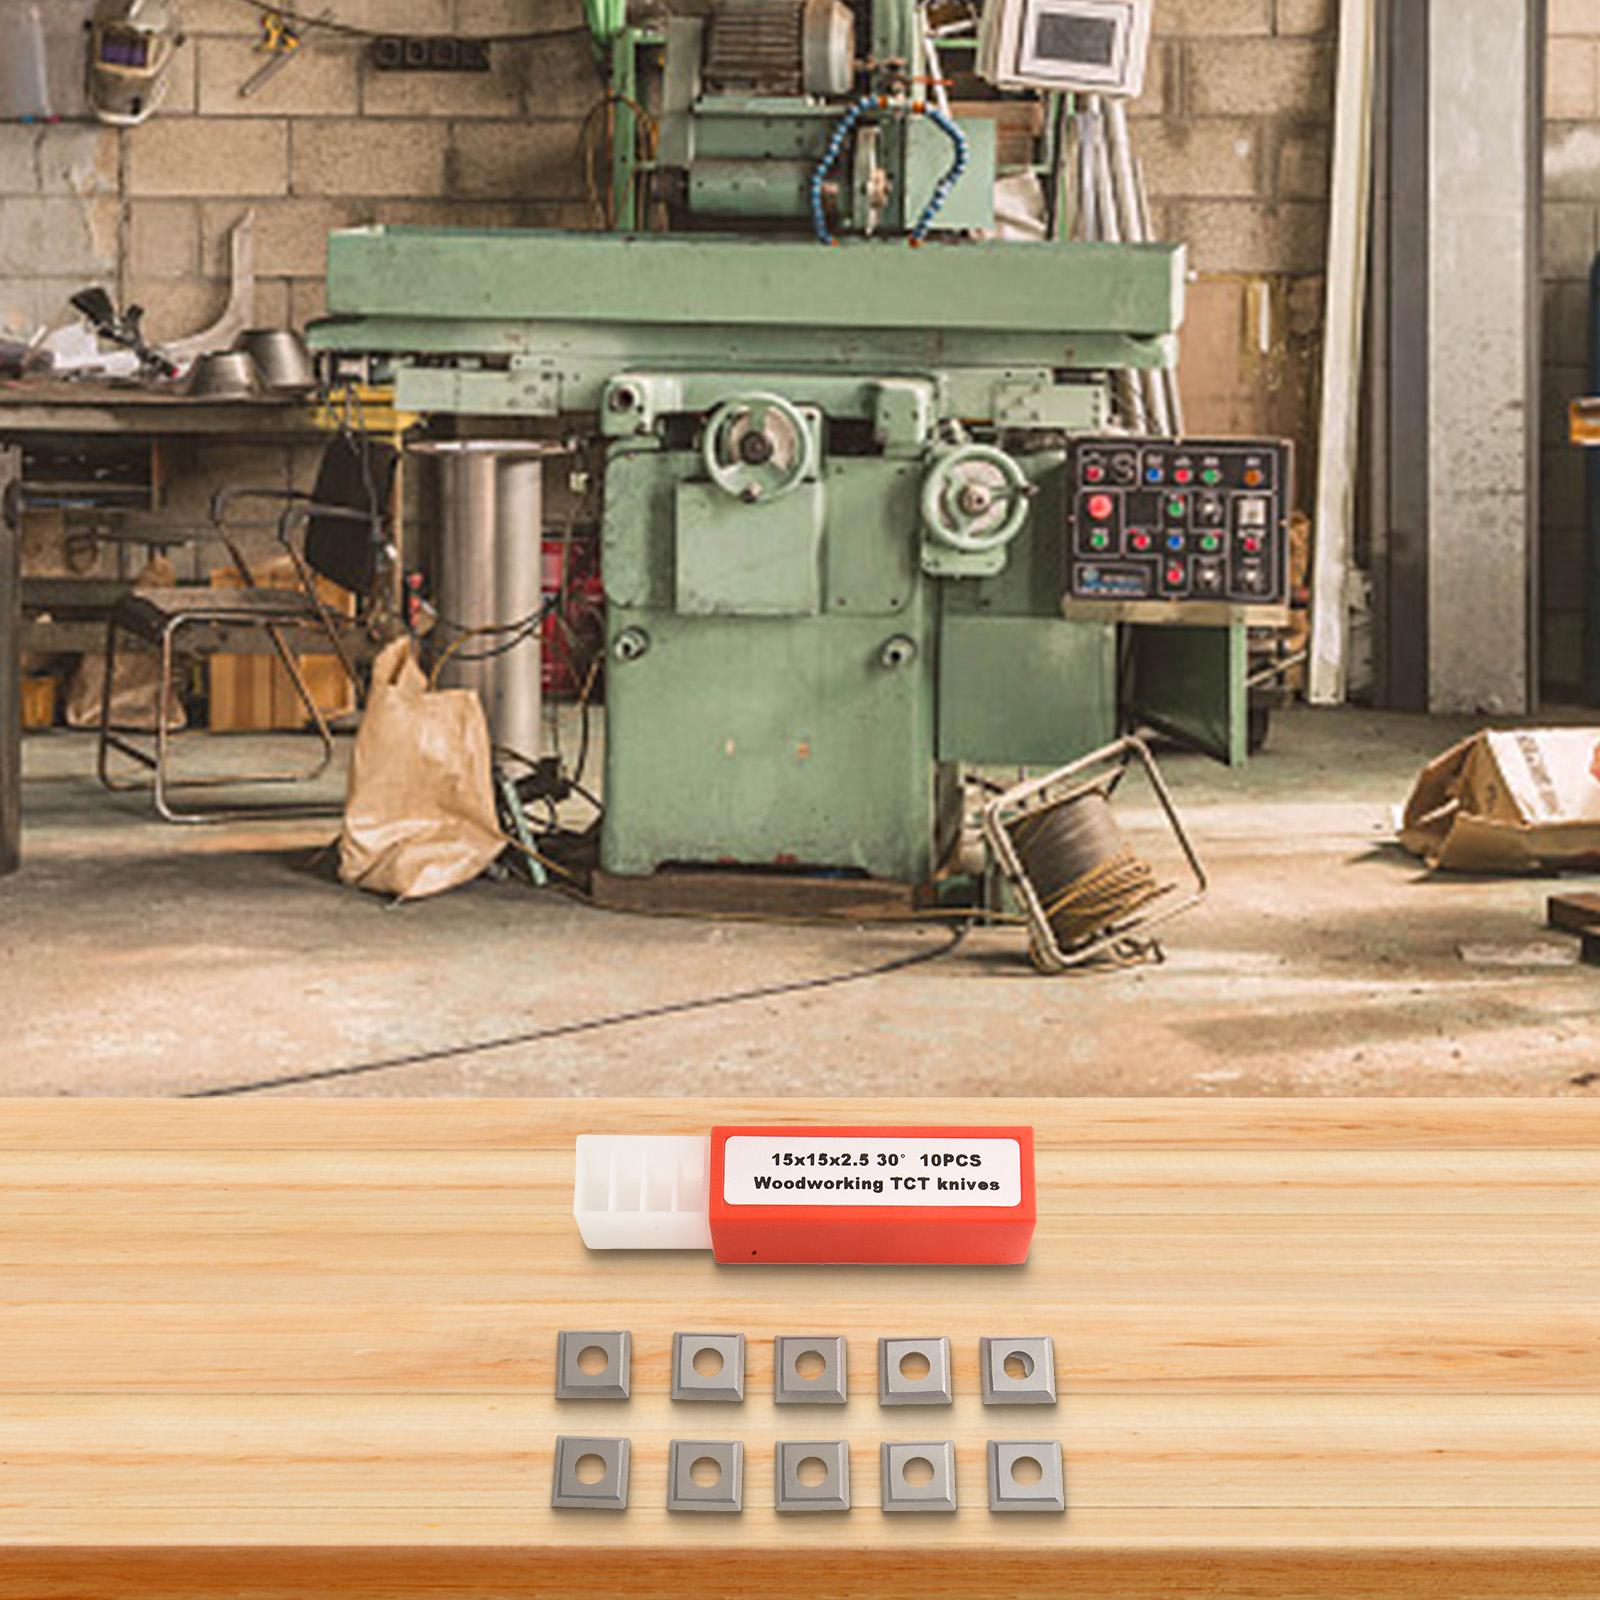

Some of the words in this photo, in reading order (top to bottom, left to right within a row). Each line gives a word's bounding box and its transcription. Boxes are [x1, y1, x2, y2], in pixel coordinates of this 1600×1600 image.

[771, 1152, 870, 1167] 15x15x2.5
[876, 1153, 907, 1167] 30°
[919, 1153, 983, 1168] 10PCS
[753, 1175, 884, 1194] Woodworking
[889, 1176, 931, 1191] TCT
[936, 1177, 1000, 1191] knives
